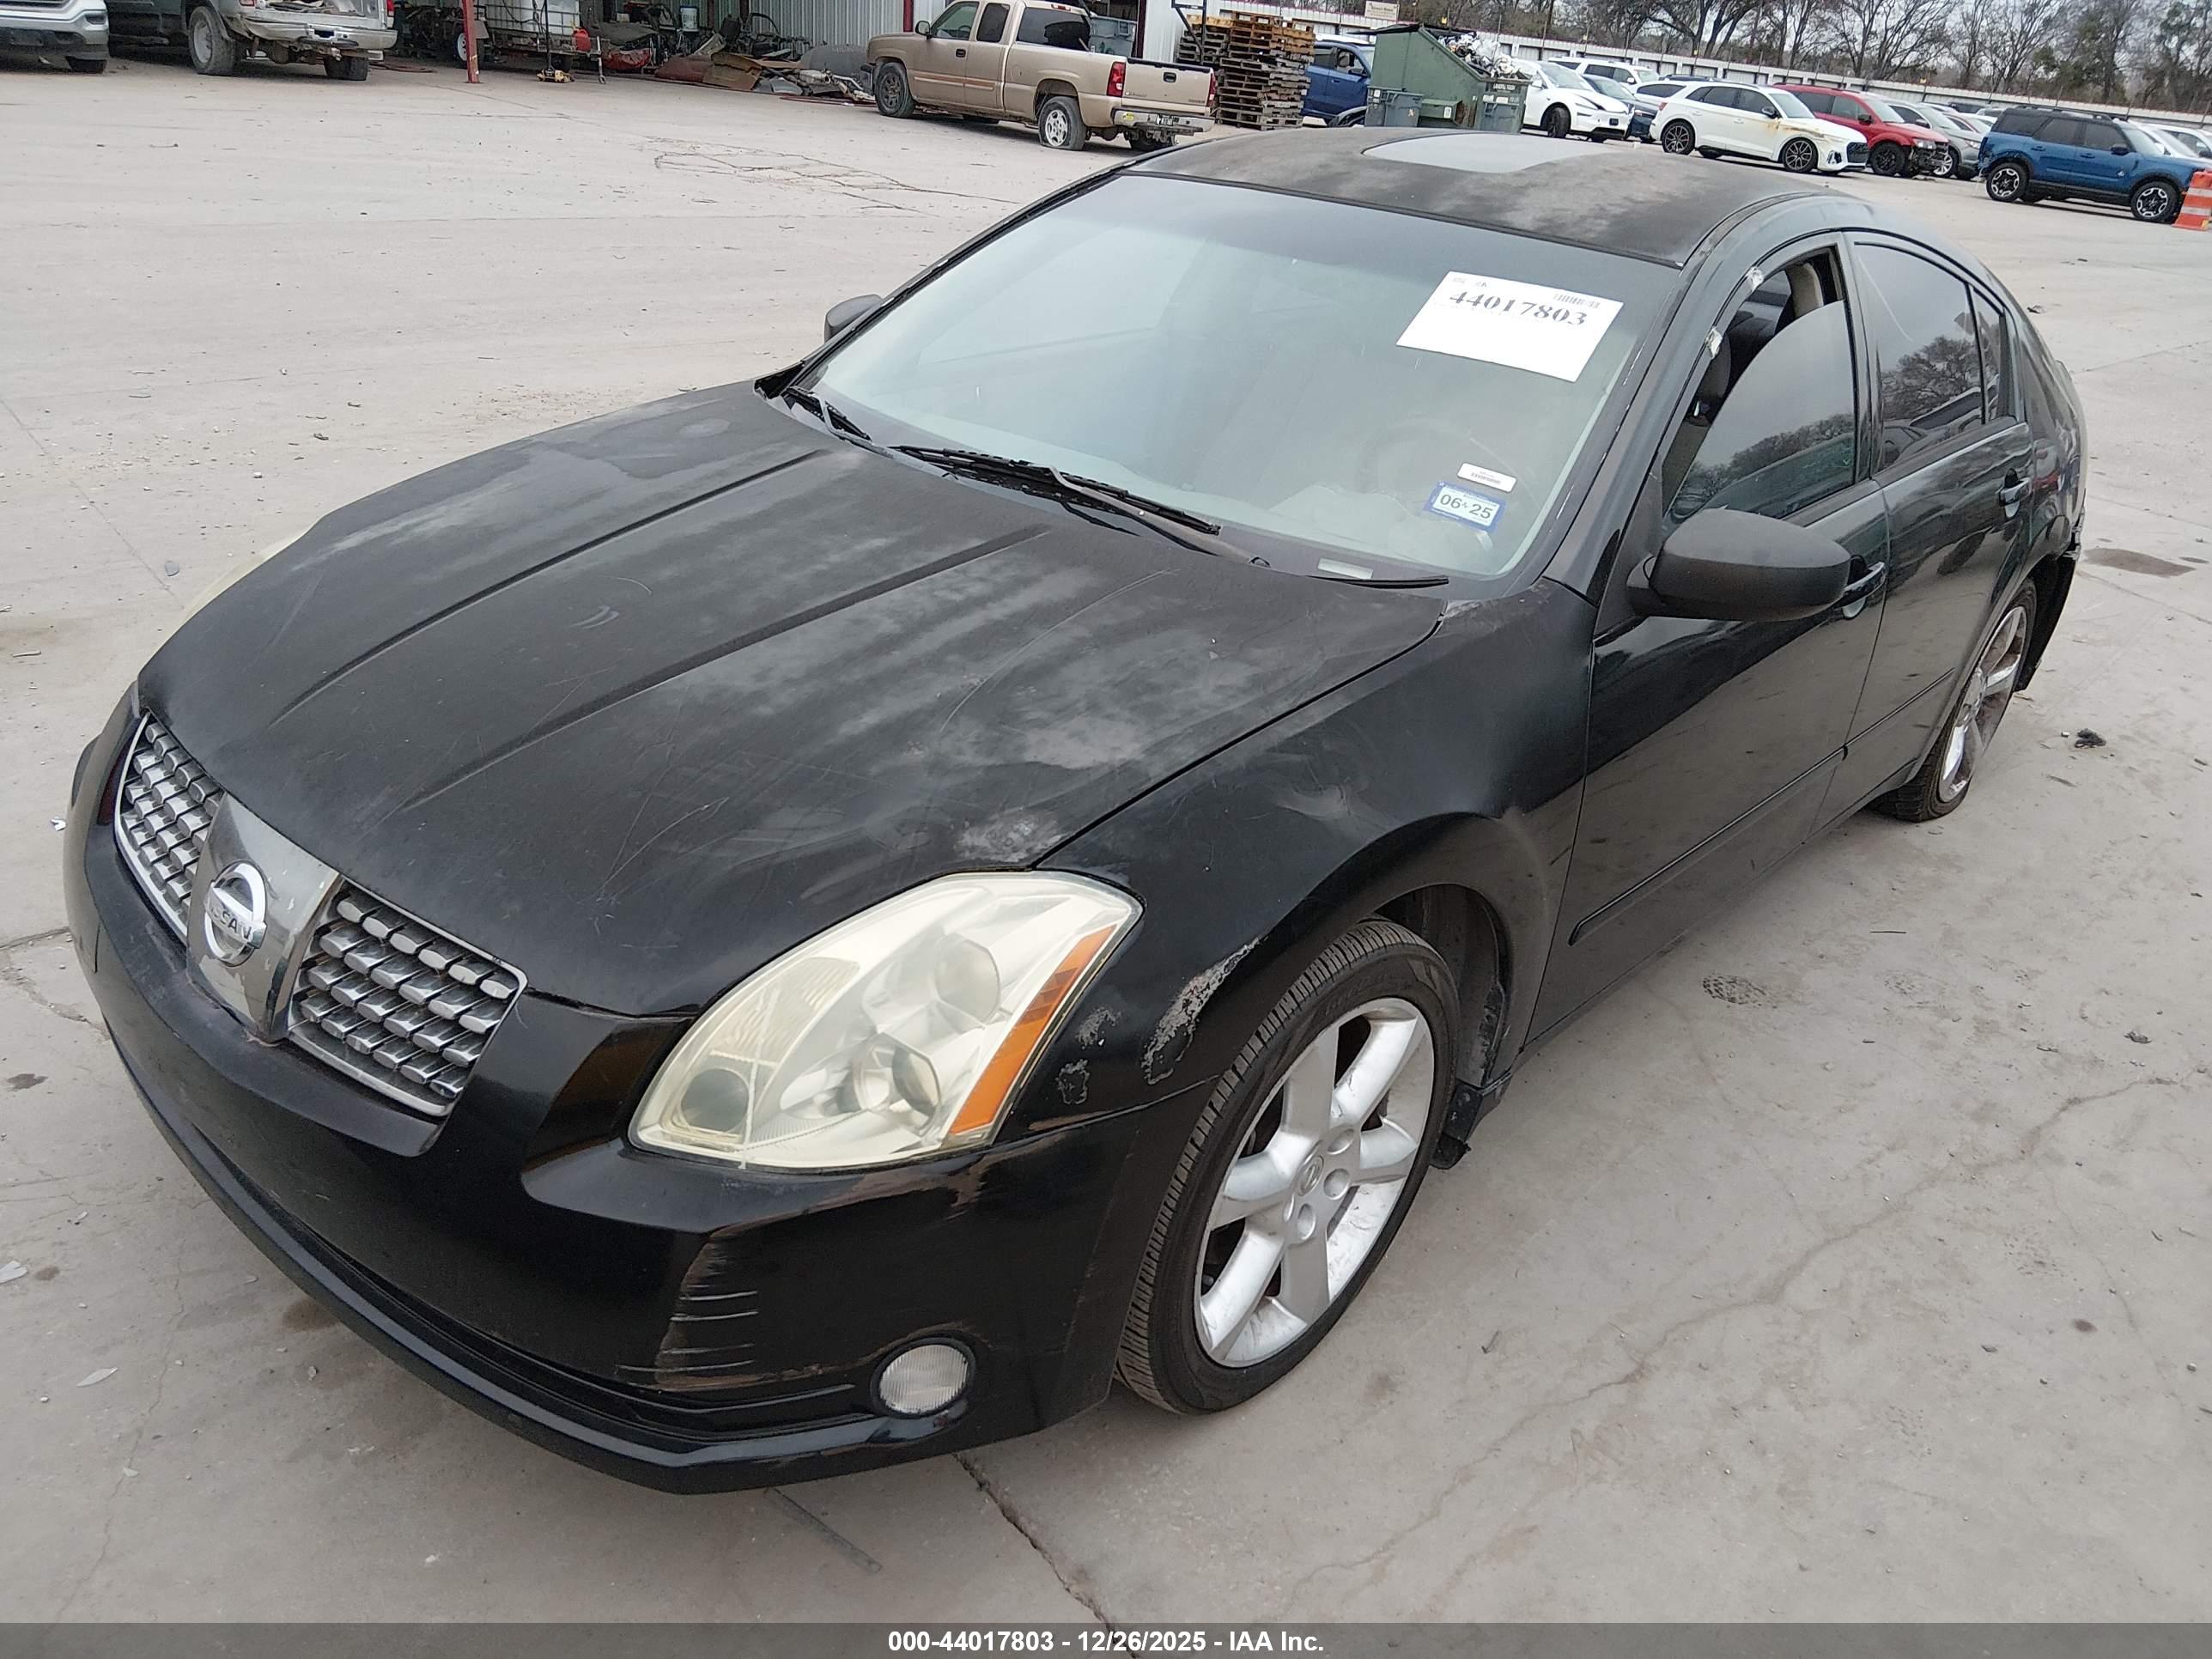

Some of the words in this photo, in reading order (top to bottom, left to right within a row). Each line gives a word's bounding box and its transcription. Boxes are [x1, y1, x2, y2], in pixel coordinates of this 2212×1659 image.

[1449, 291, 1587, 325] 44017803
[1440, 494, 1462, 508] 06
[1469, 503, 1493, 520] 25
